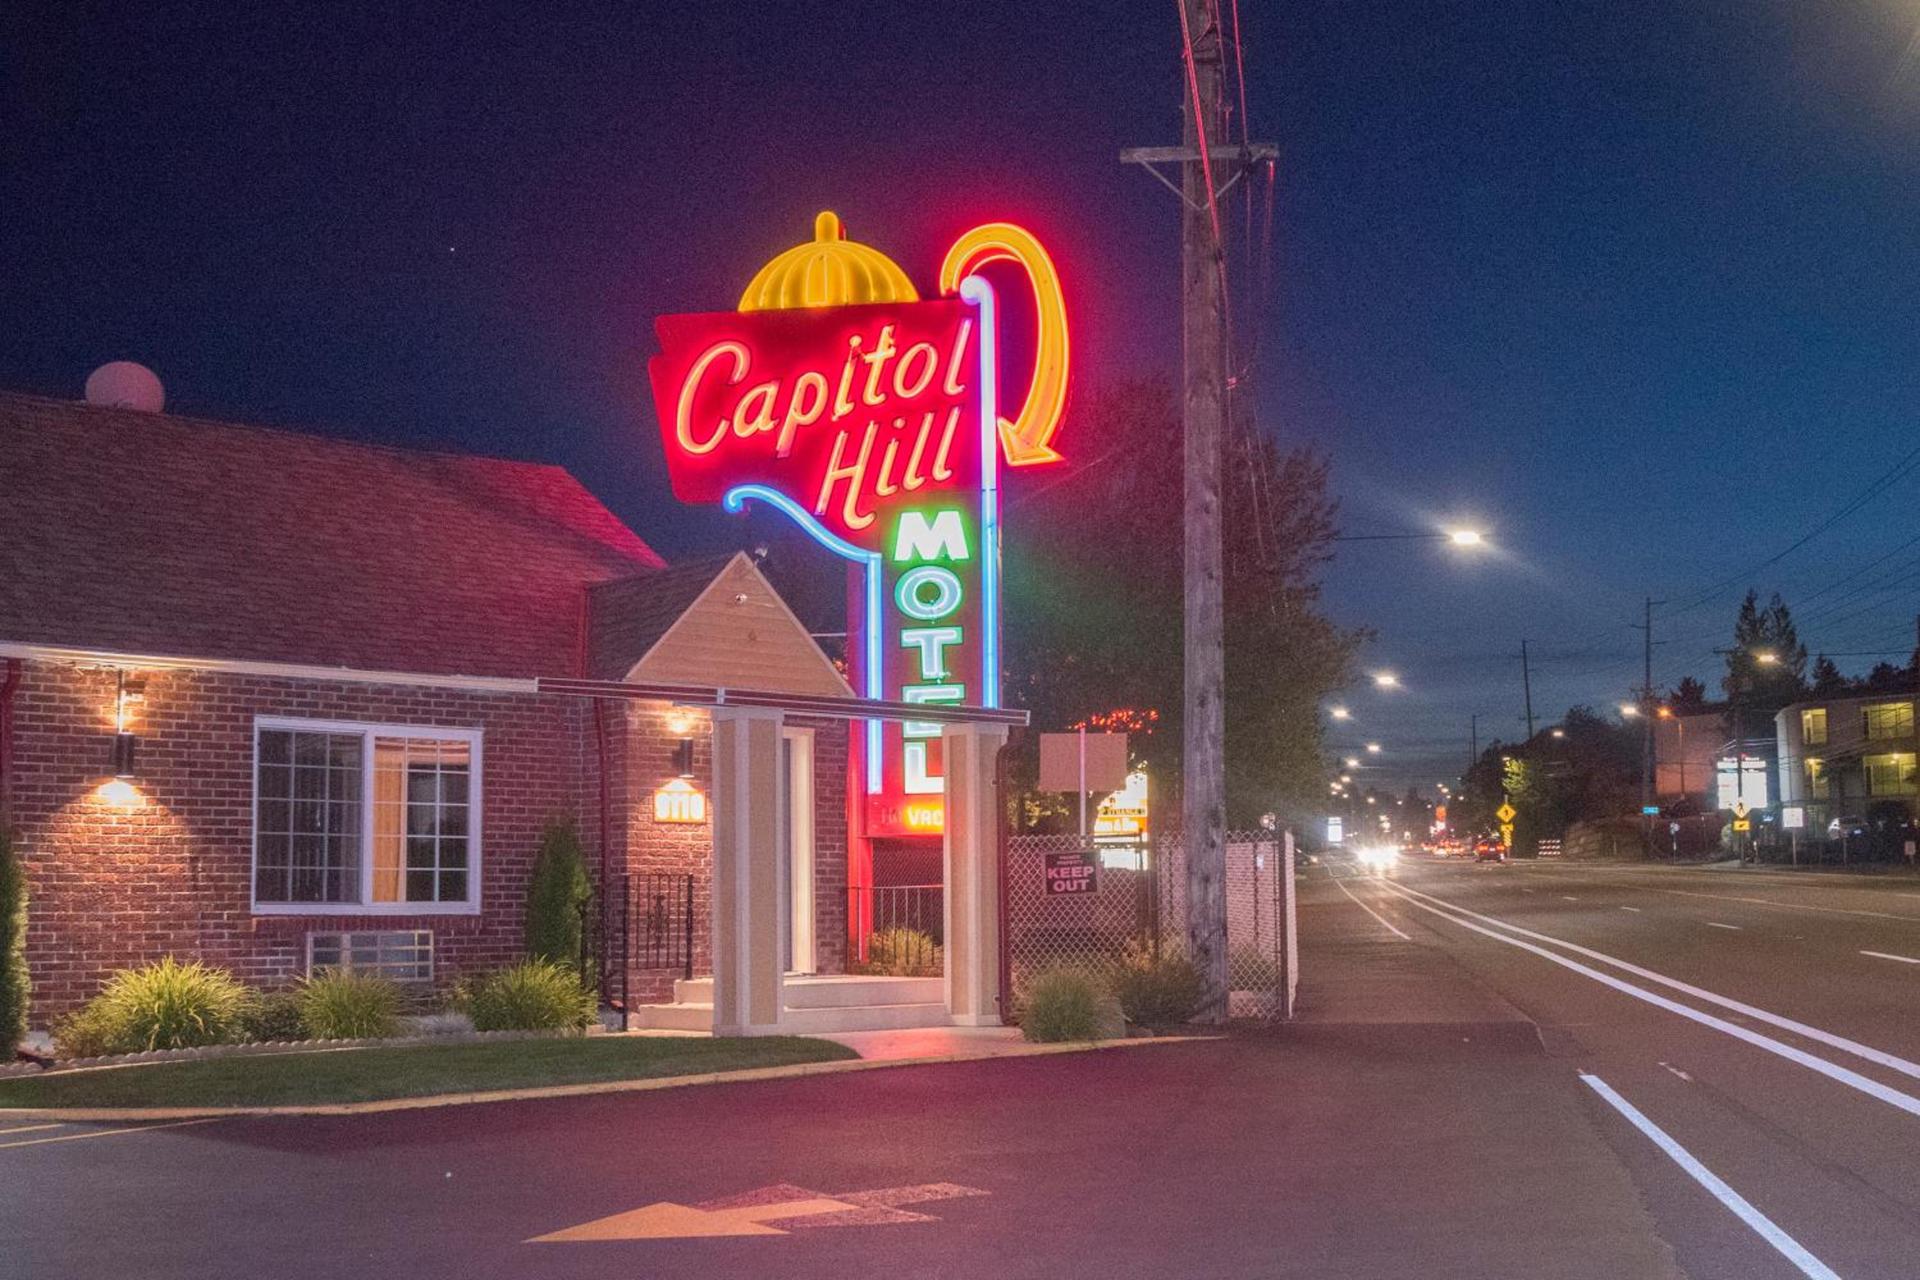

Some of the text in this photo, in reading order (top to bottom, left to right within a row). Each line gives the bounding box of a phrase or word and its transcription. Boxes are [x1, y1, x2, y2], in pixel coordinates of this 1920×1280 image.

[677, 318, 972, 458] Capitol
[815, 406, 960, 530] Hill
[893, 510, 970, 795] MOTEL
[1047, 866, 1094, 879] KEEP
[1053, 879, 1090, 892] OUT
